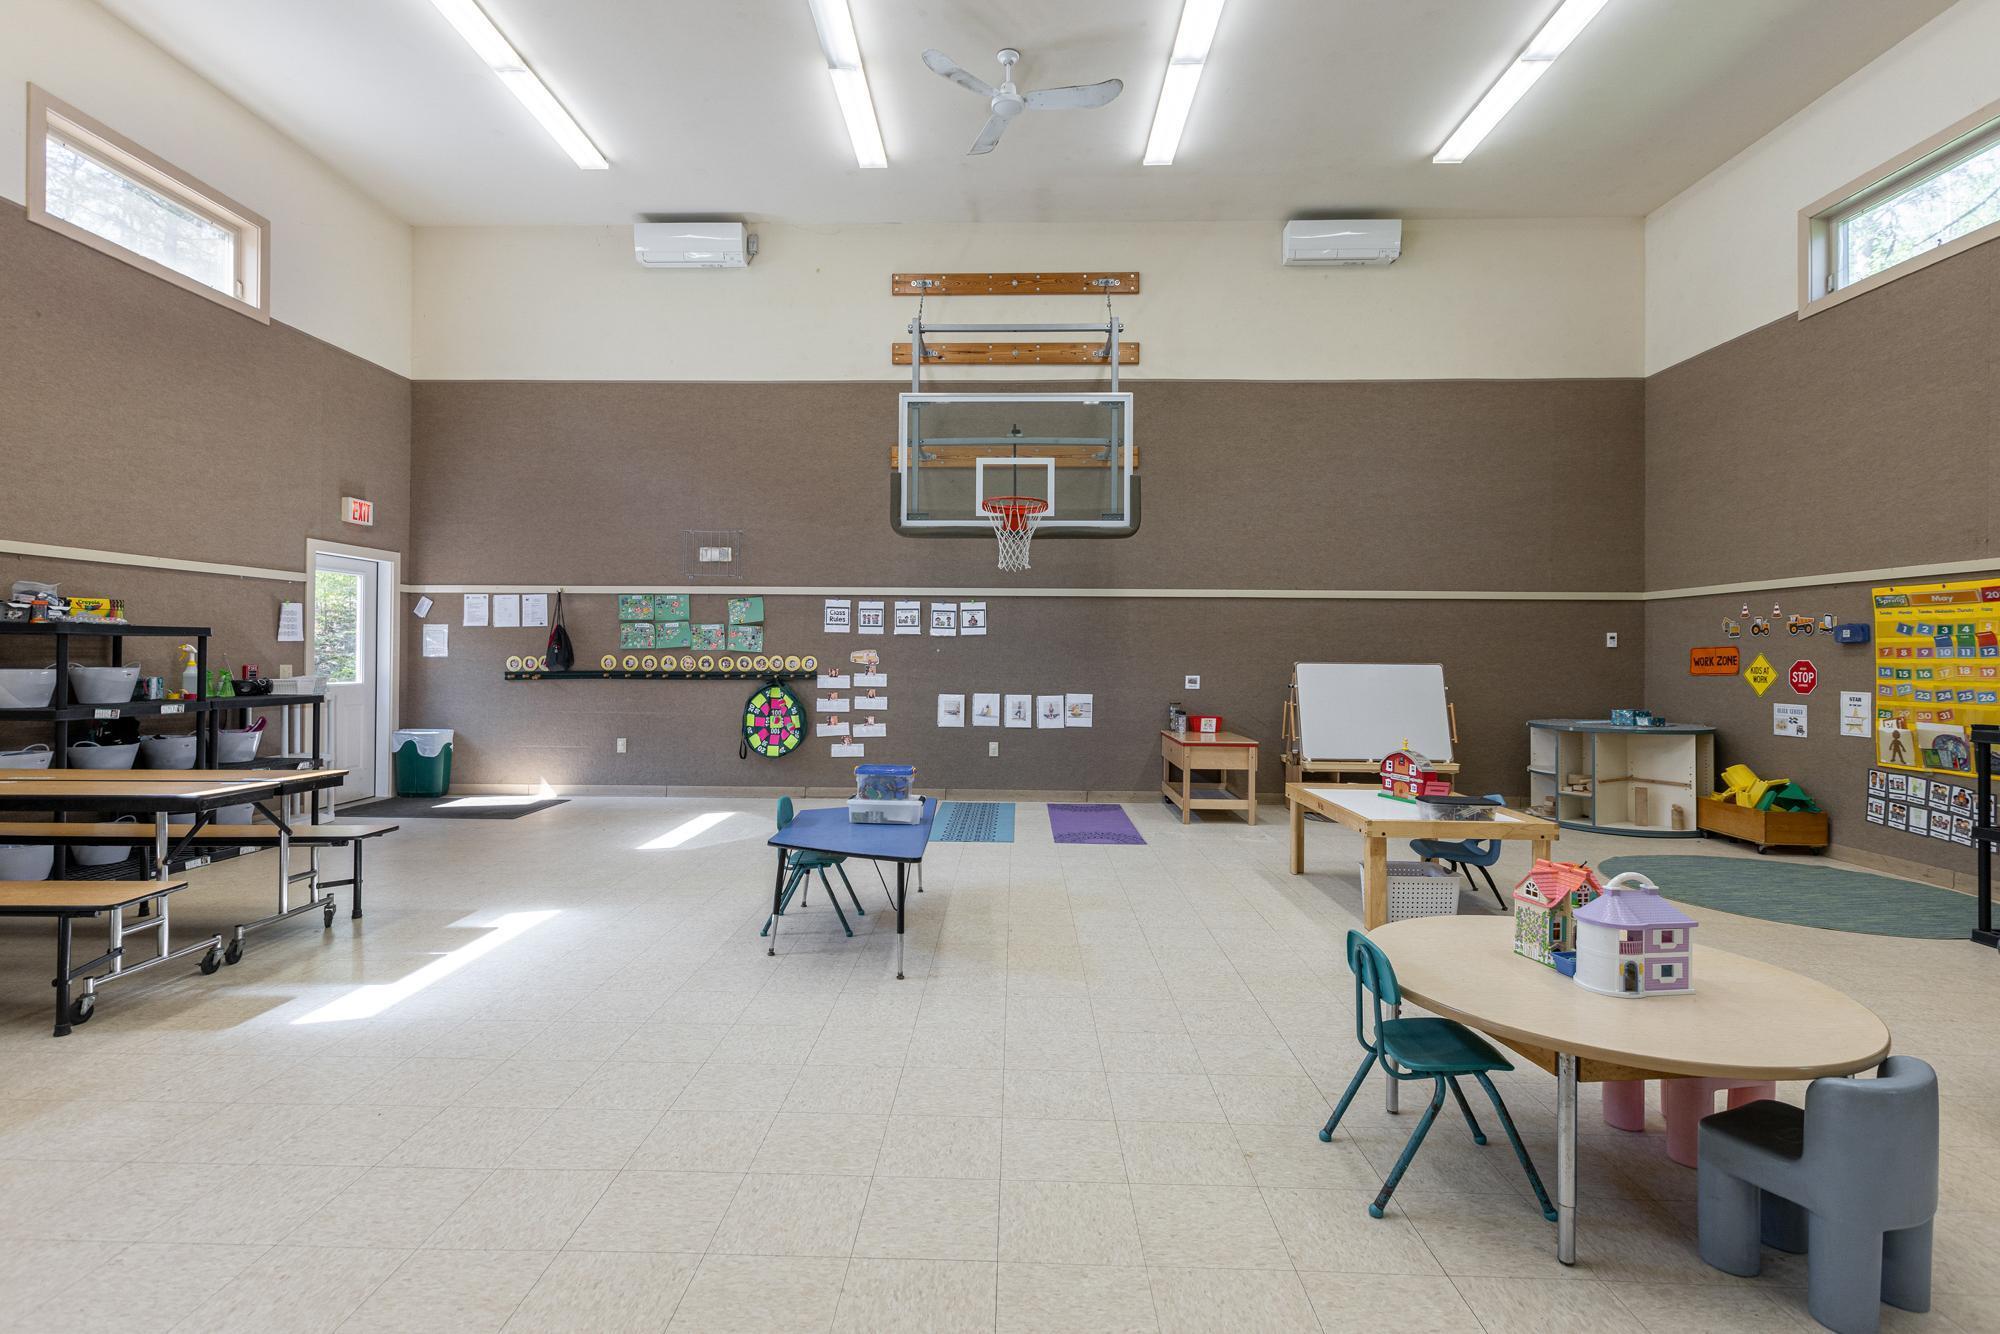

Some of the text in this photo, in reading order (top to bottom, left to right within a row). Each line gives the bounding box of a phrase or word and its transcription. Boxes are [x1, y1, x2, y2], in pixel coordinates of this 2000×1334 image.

[352, 500, 370, 523] EXIT
[1931, 595, 1953, 603] May
[1985, 591, 2000, 599] 20
[1983, 648, 1995, 656] 12
[1693, 655, 1738, 667] WORK ZONE
[1750, 666, 1770, 675] KIDS AT
[1880, 668, 1891, 676] 14
[1898, 670, 1909, 678] 15
[1919, 670, 1930, 678] 16
[1959, 667, 1971, 675] 18
[1981, 668, 1995, 676] 19
[1752, 675, 1768, 684] WORK
[1792, 671, 1815, 684] STOP
[1880, 685, 1995, 702] 21 22 23 24 25 26
[1880, 710, 1892, 718] 28
[1918, 712, 1932, 720] 30
[1939, 712, 1951, 720] 31
